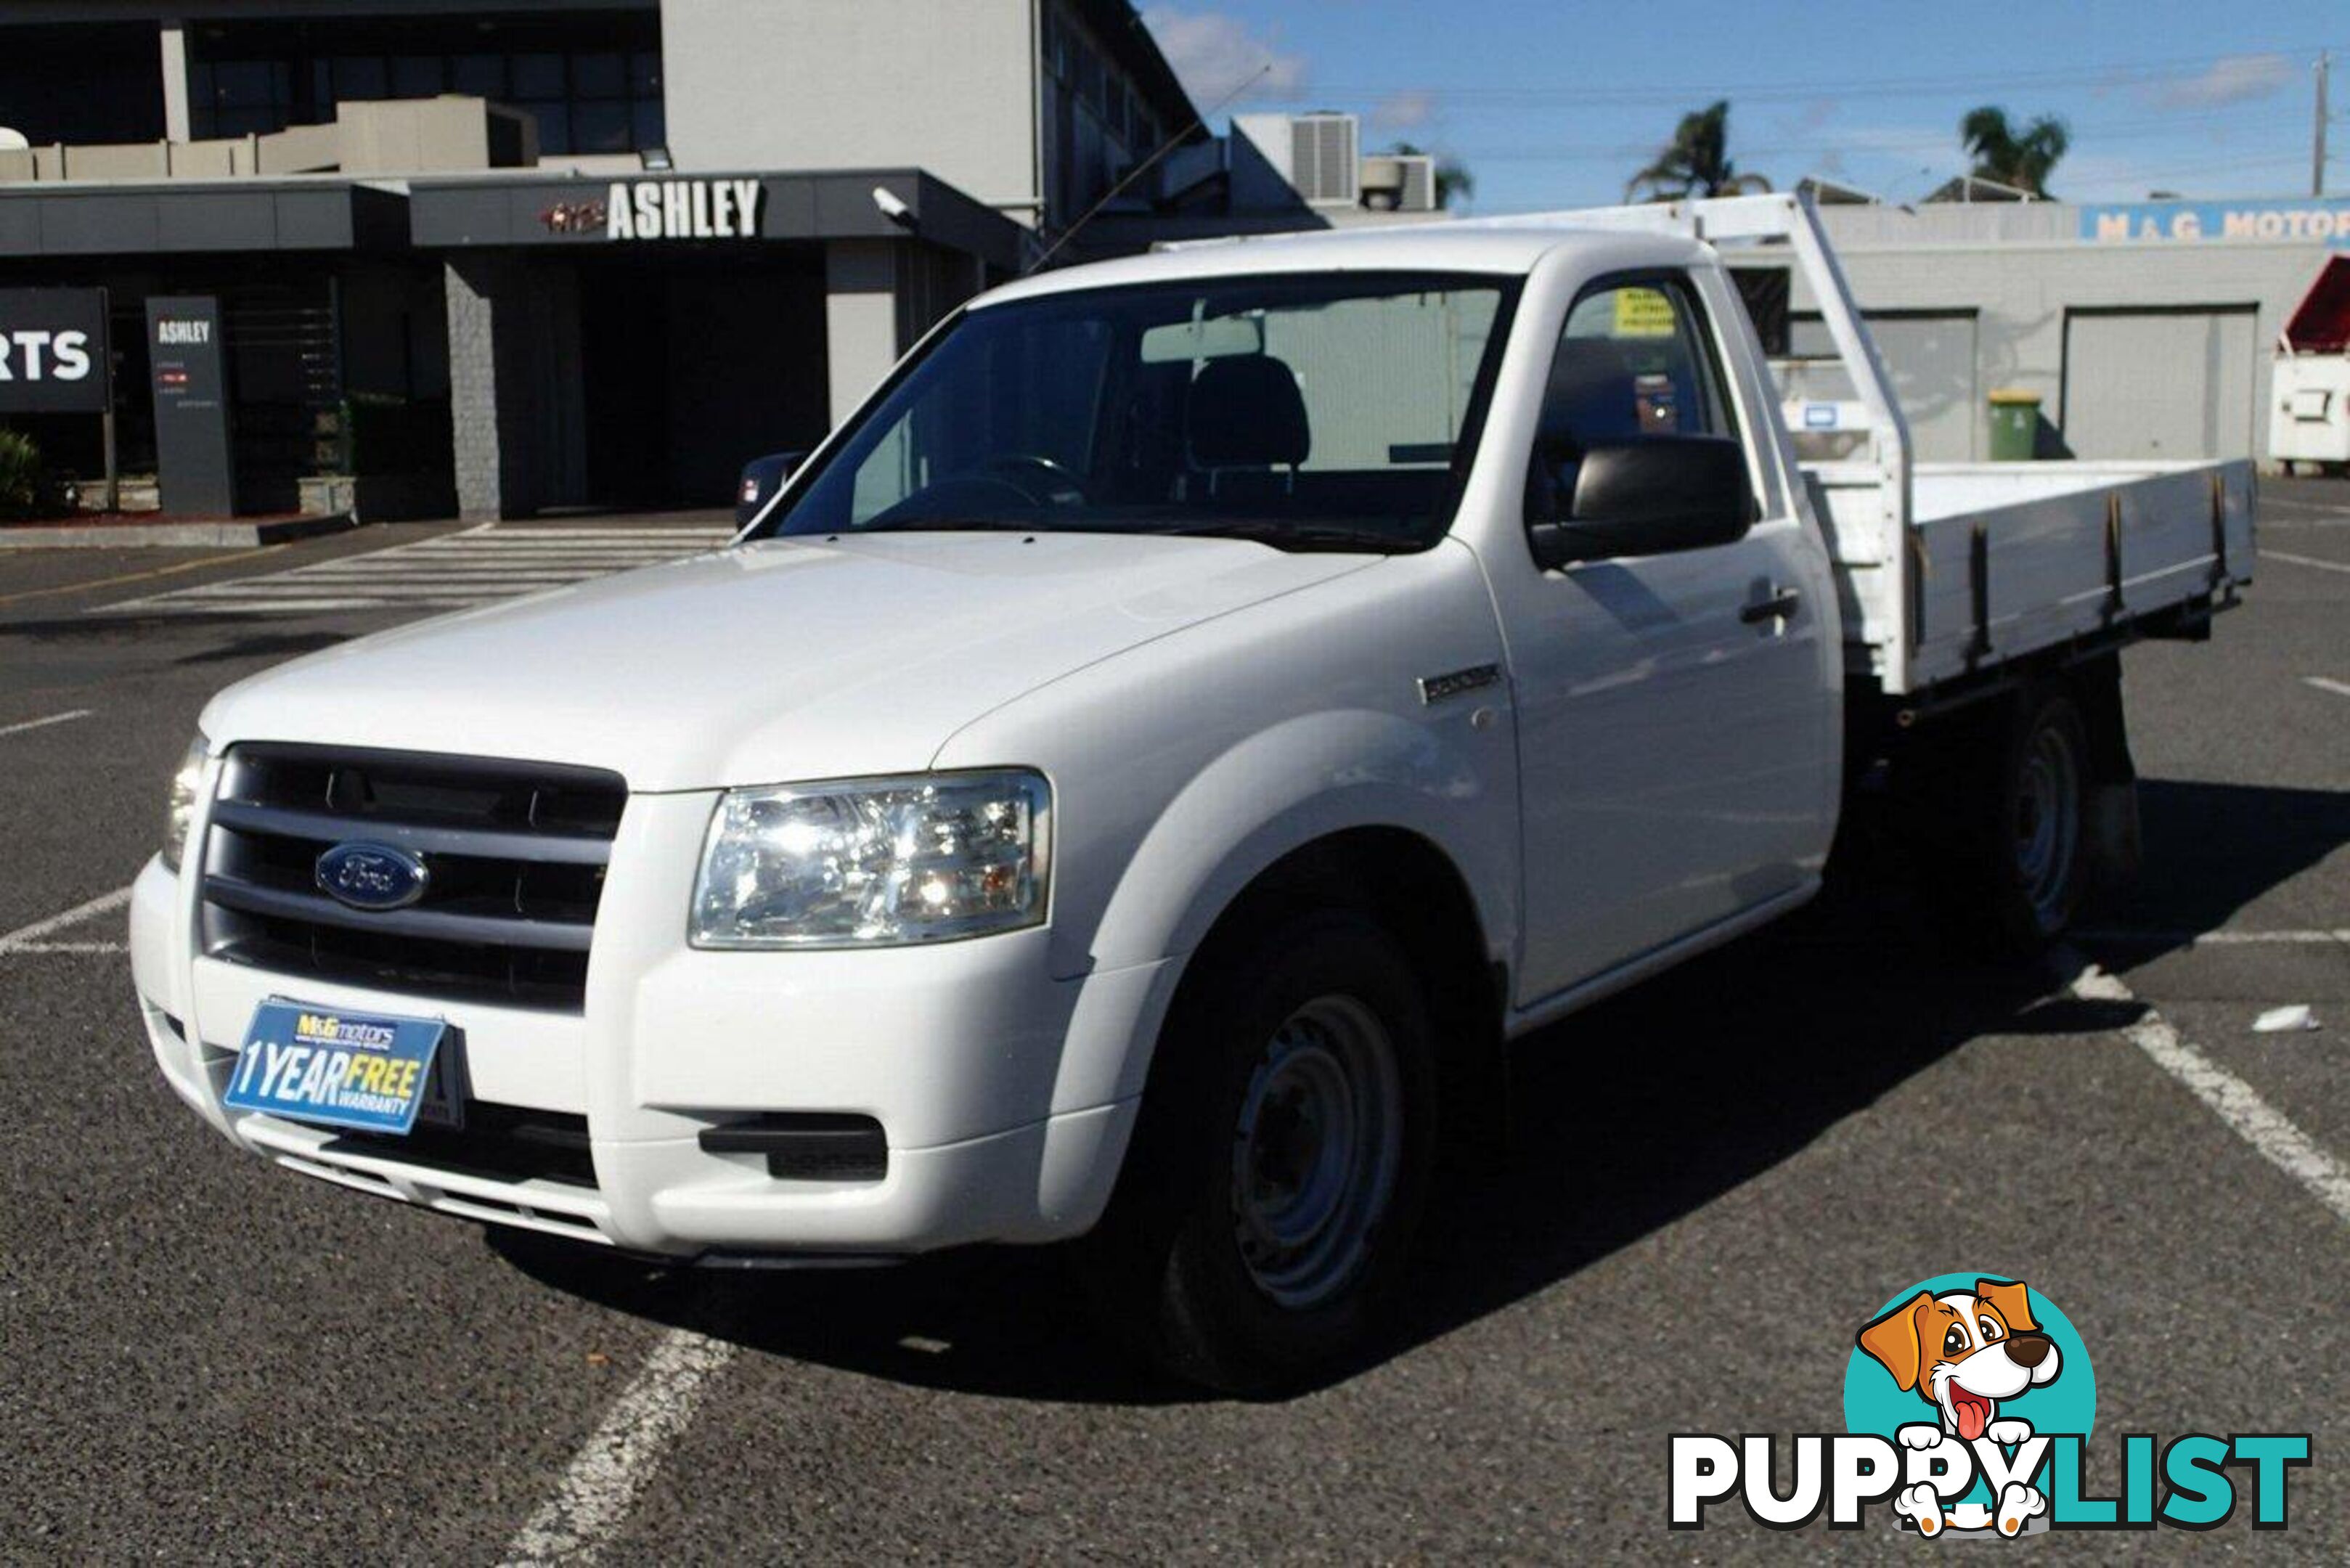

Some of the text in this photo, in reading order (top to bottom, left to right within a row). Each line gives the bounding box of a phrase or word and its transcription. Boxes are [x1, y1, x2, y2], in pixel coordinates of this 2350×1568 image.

[607, 179, 759, 239] ASHLEY
[2097, 213, 2129, 242] M
[159, 321, 209, 343] ASHLEY
[238, 1040, 262, 1093] 1
[258, 1042, 350, 1106] YEAR
[344, 1053, 420, 1098] FREE
[338, 1090, 410, 1115] WARRANTY
